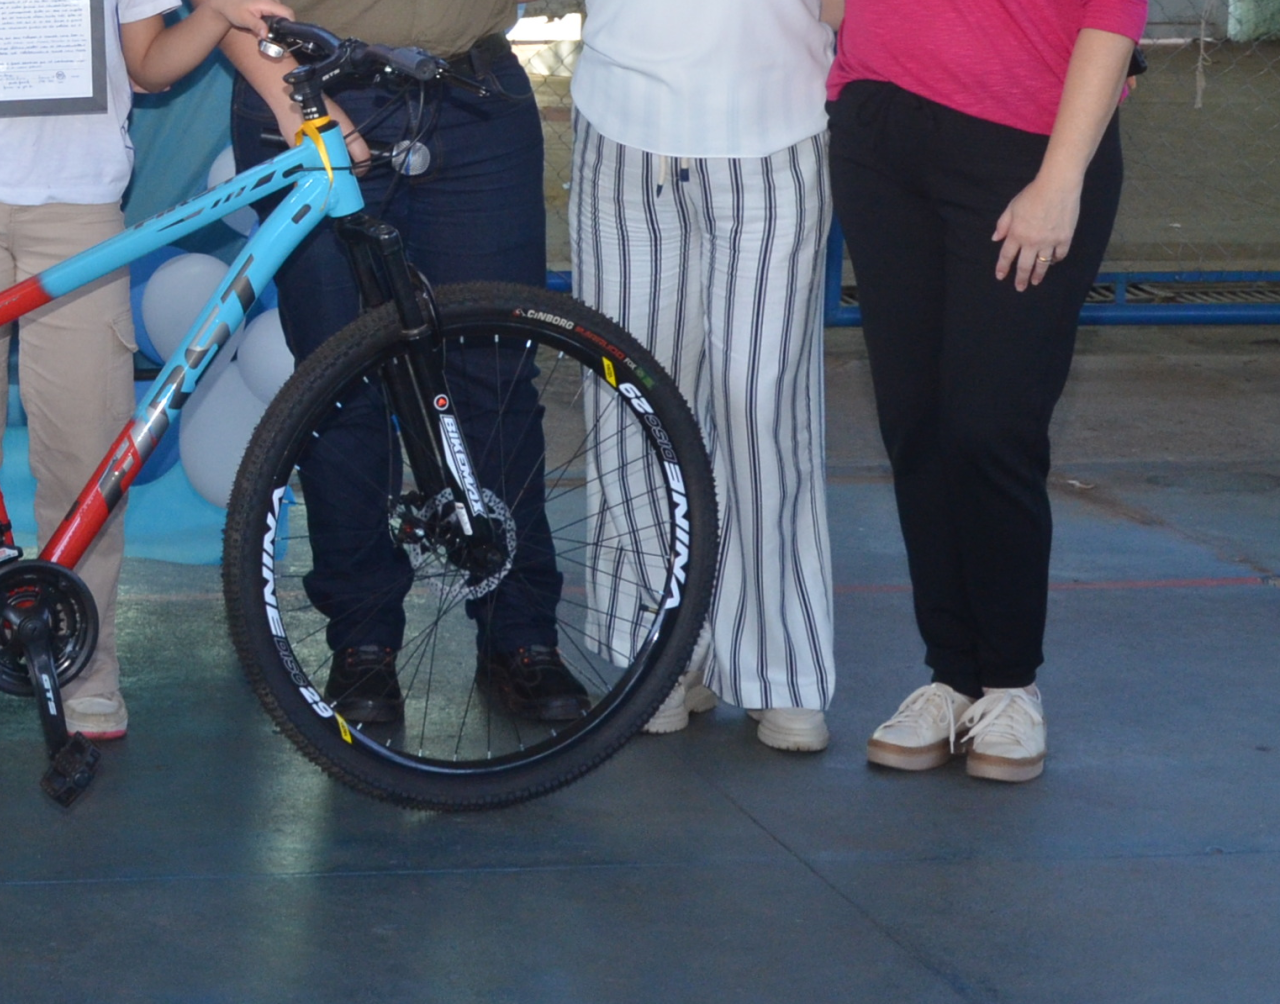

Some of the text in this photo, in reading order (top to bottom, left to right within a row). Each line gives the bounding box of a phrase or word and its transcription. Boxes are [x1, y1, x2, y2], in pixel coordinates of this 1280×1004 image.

[97, 253, 256, 513] FIRST
[618, 382, 655, 414] 29
[443, 416, 485, 515] BIKEMAX
[643, 412, 678, 465] DISC
[42, 673, 58, 716] GTS
[274, 637, 307, 688] DISC
[299, 686, 334, 719] 29
